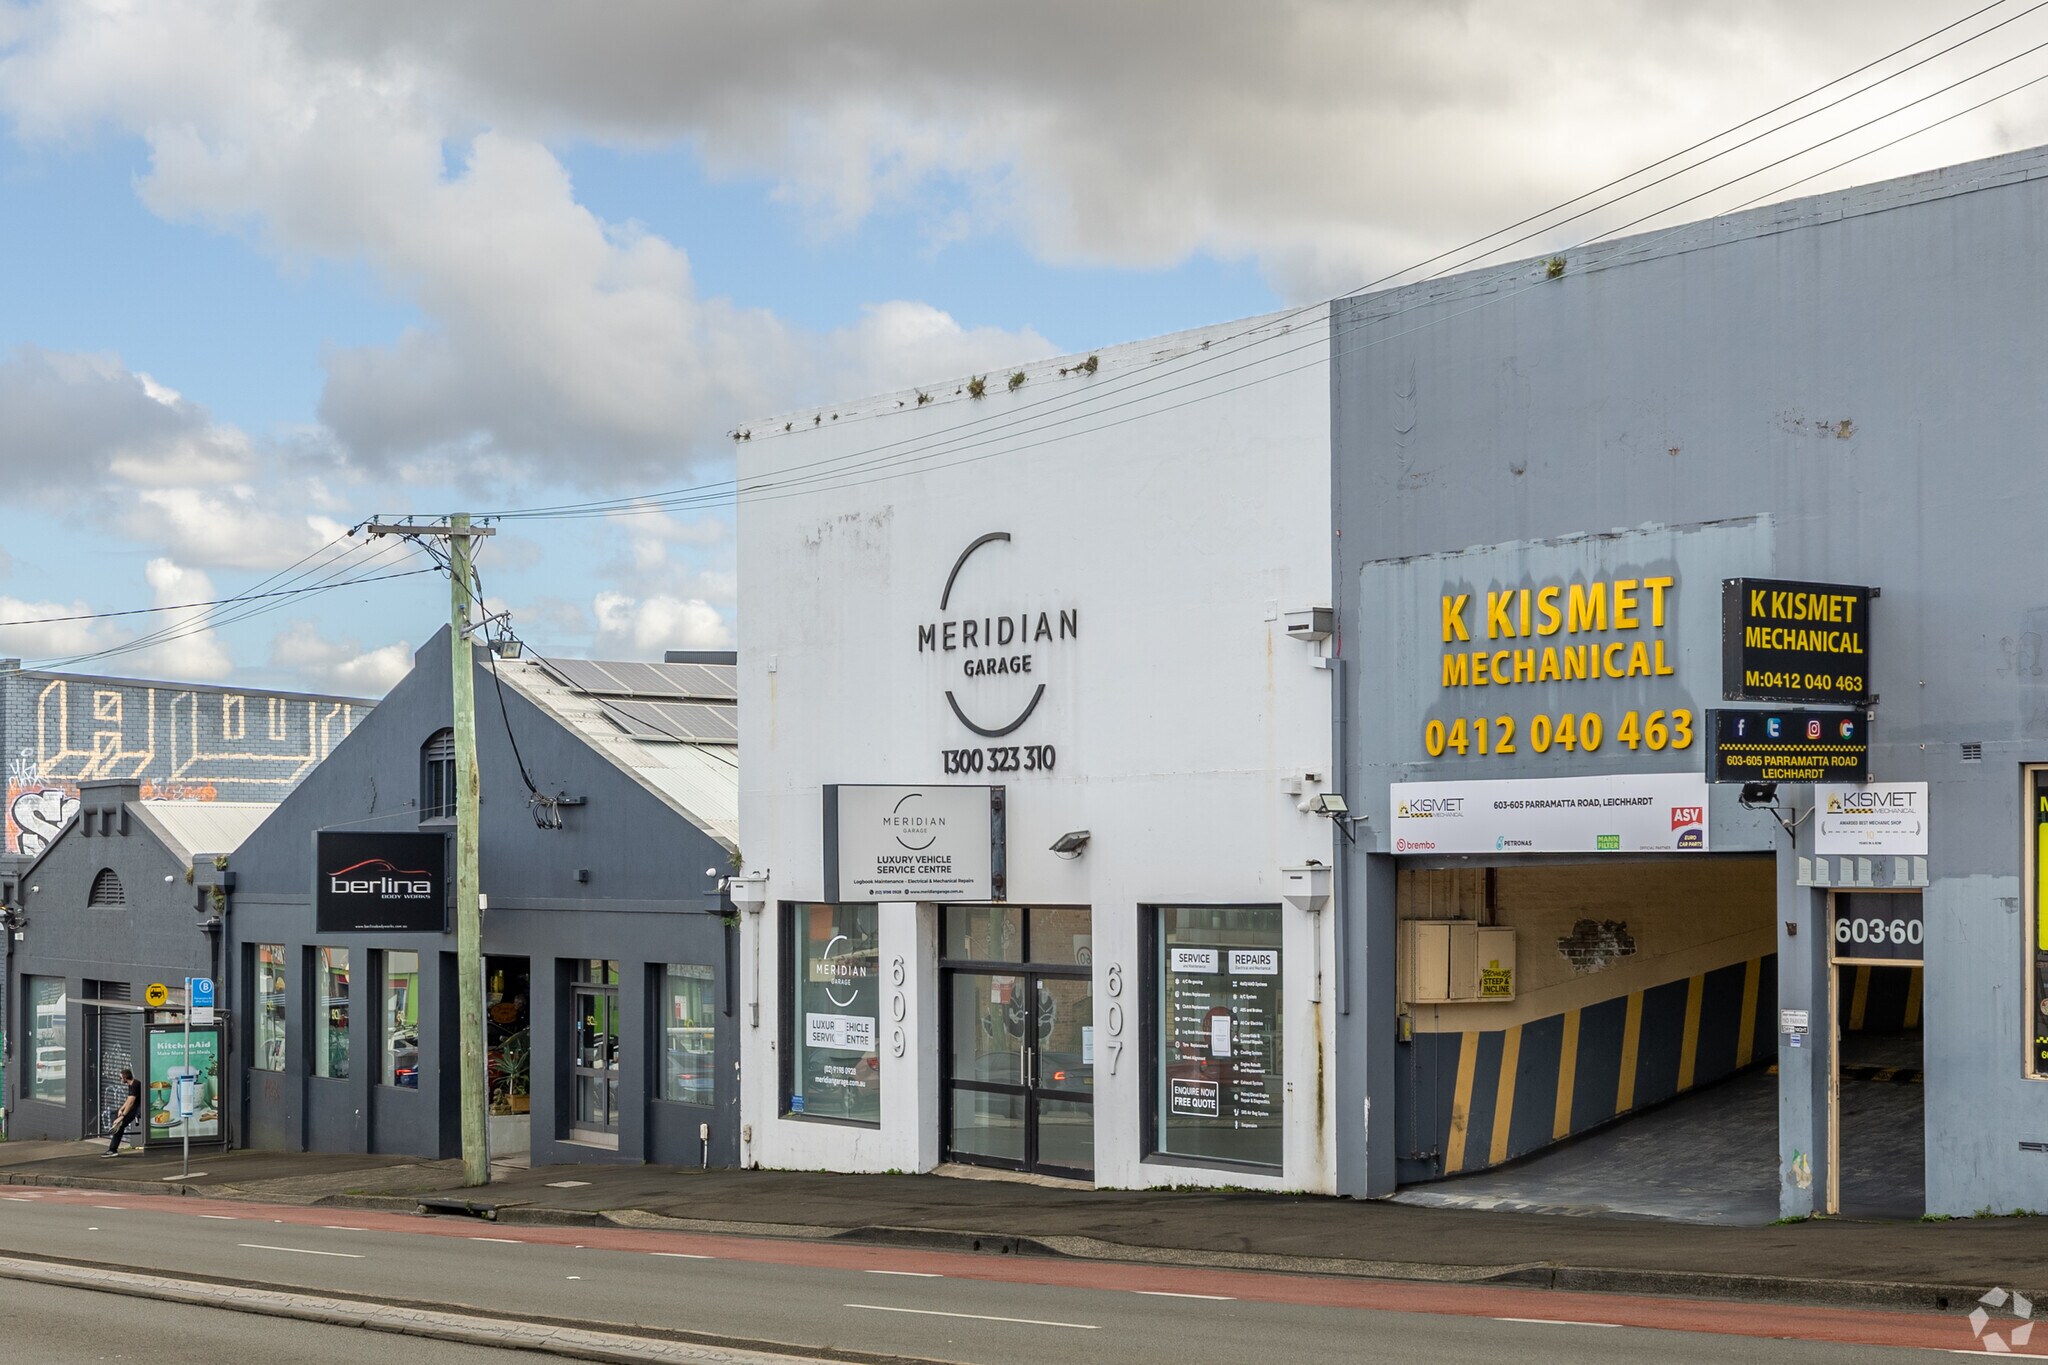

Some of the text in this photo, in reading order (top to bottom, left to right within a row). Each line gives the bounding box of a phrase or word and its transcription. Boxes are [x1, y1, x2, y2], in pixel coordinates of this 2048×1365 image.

[1441, 576, 1674, 643] K KISMET
[1751, 589, 1857, 623] K KISMET
[918, 608, 1077, 653] MERIDIAN
[1745, 626, 1863, 654] MECHANICAL
[963, 654, 1032, 677] GARAGE
[1441, 639, 1674, 688] MECHANICAL
[1745, 670, 1863, 692] M:0412 040 463
[1425, 708, 1694, 757] 0412 040 463
[941, 744, 1056, 775] 1300 323 310
[1726, 756, 1858, 767] 603-605 PARRAMATTA ROAD
[1762, 769, 1825, 779] LEICHHARDT
[1410, 798, 1464, 812] KISMET
[1493, 797, 1653, 810] 603-605 PARRAMATTA ROAD, LEICHHARDT
[1843, 791, 1917, 807] KISMET
[882, 817, 946, 826] MERIDIAN
[1673, 808, 1699, 822] ASV
[1406, 841, 1436, 850] brembo
[876, 855, 952, 864] LUXURY VEHICLE
[876, 865, 952, 874] SERVICE CENTRE
[331, 876, 431, 894] berlina
[1178, 953, 1210, 964] SERVICE
[1235, 954, 1271, 965] REPAIRS
[816, 963, 867, 977] MERIDIAN
[202, 983, 209, 991] B
[831, 977, 851, 986] GARAGE
[812, 1020, 869, 1033] LUXUR EHICLE
[812, 1032, 869, 1045] SERVIC ENTRE
[815, 1076, 866, 1088] meridiangarage.com.au
[1174, 1085, 1216, 1098] ENQUIRE NOW
[1174, 1096, 1216, 1110] FREE QUOTE
